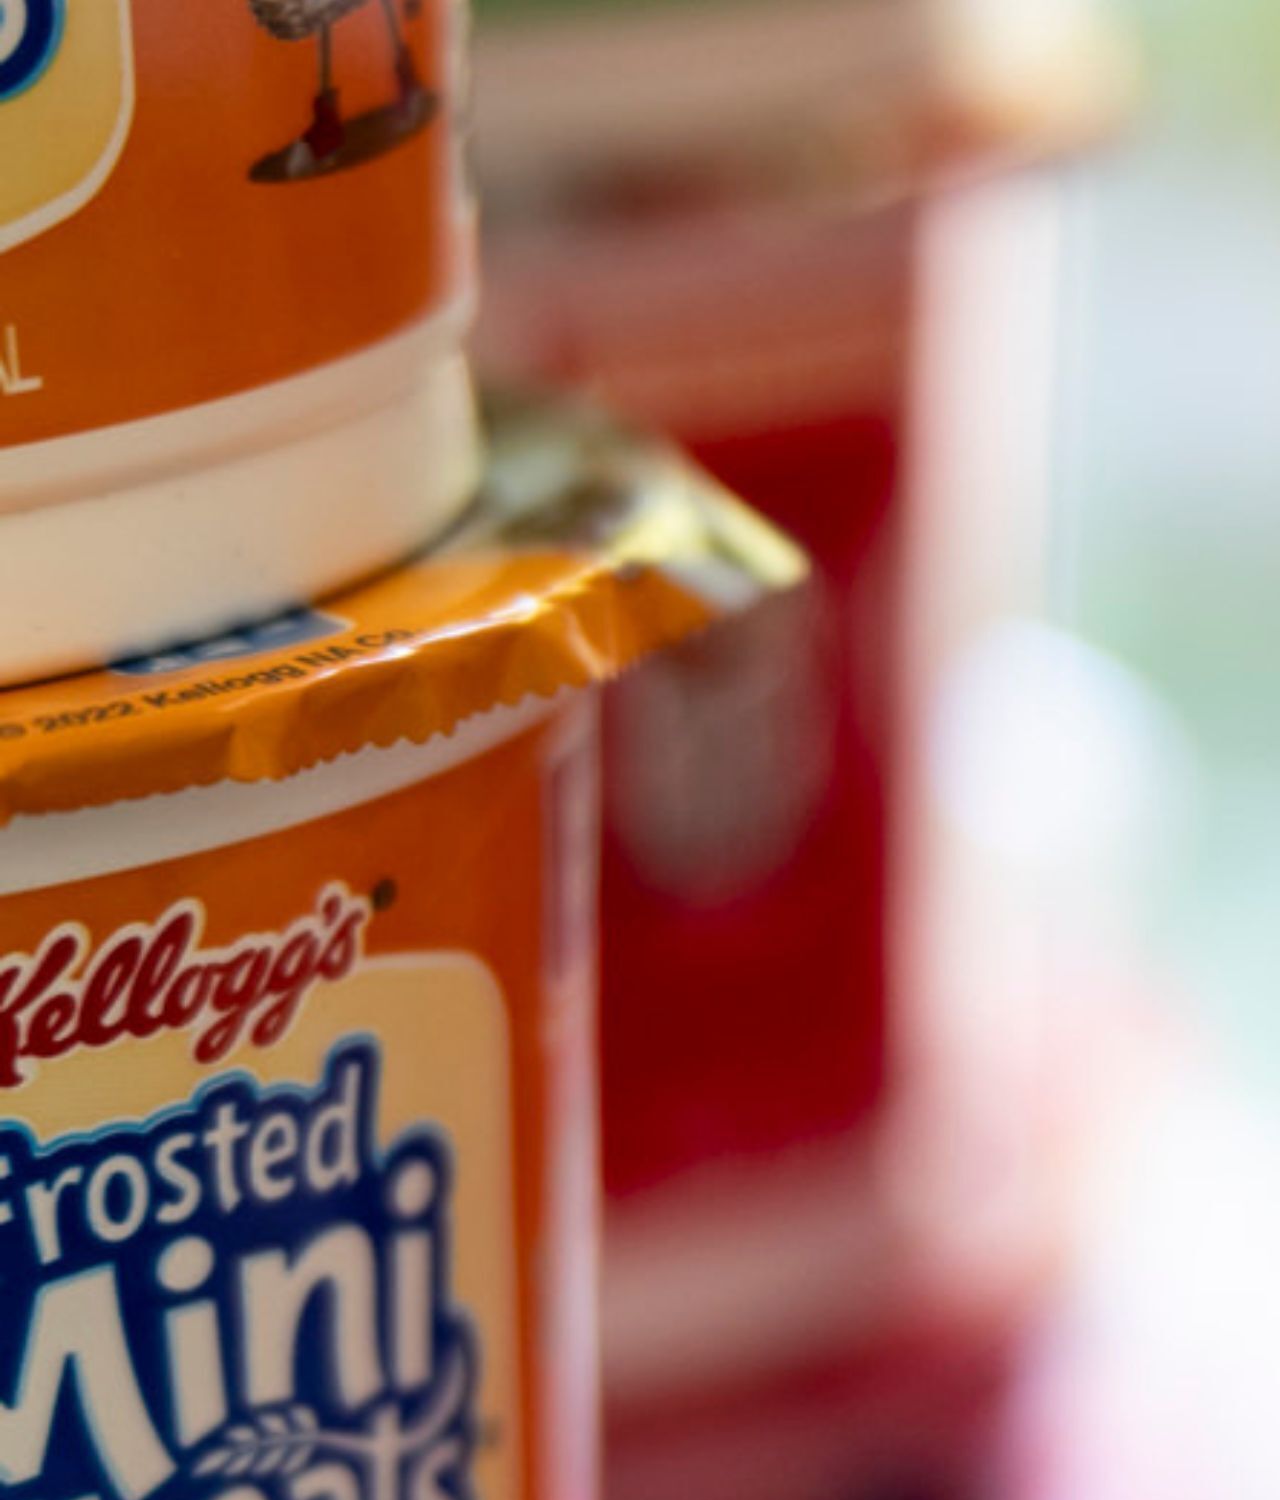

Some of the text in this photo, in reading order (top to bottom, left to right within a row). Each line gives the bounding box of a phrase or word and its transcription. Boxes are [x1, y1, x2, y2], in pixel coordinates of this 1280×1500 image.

[143, 663, 306, 707] Kellogg
[0, 890, 368, 1088] Kellogg's
[0, 1062, 362, 1265] rosted
